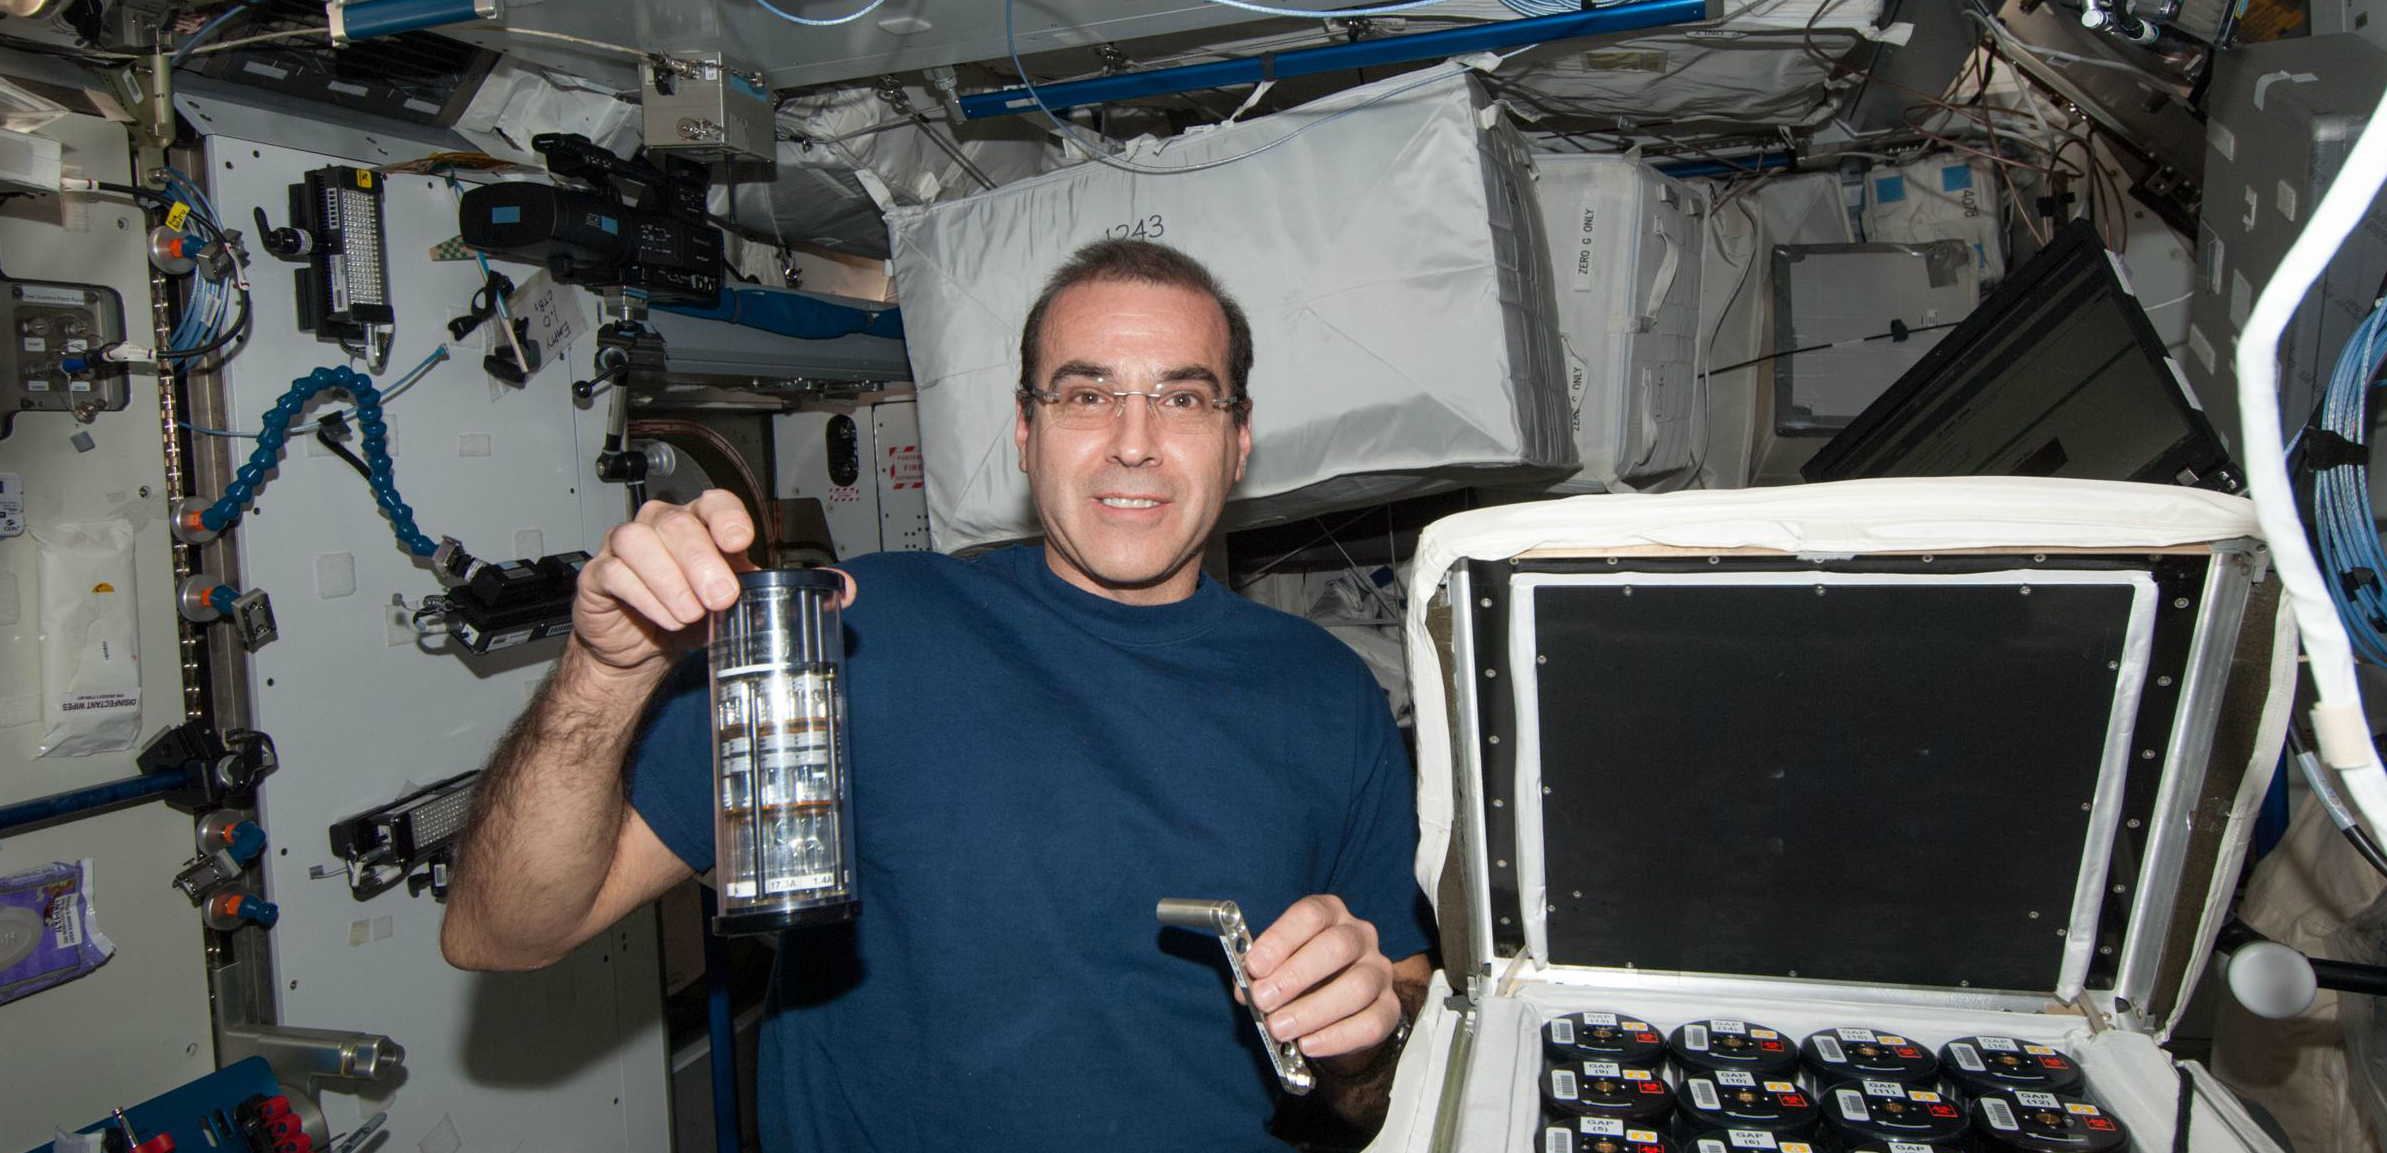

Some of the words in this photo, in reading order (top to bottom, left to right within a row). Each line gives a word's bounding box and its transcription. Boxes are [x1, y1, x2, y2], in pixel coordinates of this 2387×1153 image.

[1106, 214, 1164, 241] 1243
[1578, 250, 1590, 275] ZERO
[1584, 208, 1595, 233] ONLY
[1573, 367, 1582, 389] ONLY
[904, 464, 924, 472] FIRE
[62, 702, 84, 711] WIPES
[87, 698, 137, 710] DISINFECTANT
[2021, 1092, 2051, 1100] GAP
[1744, 1138, 1761, 1146] (6)
